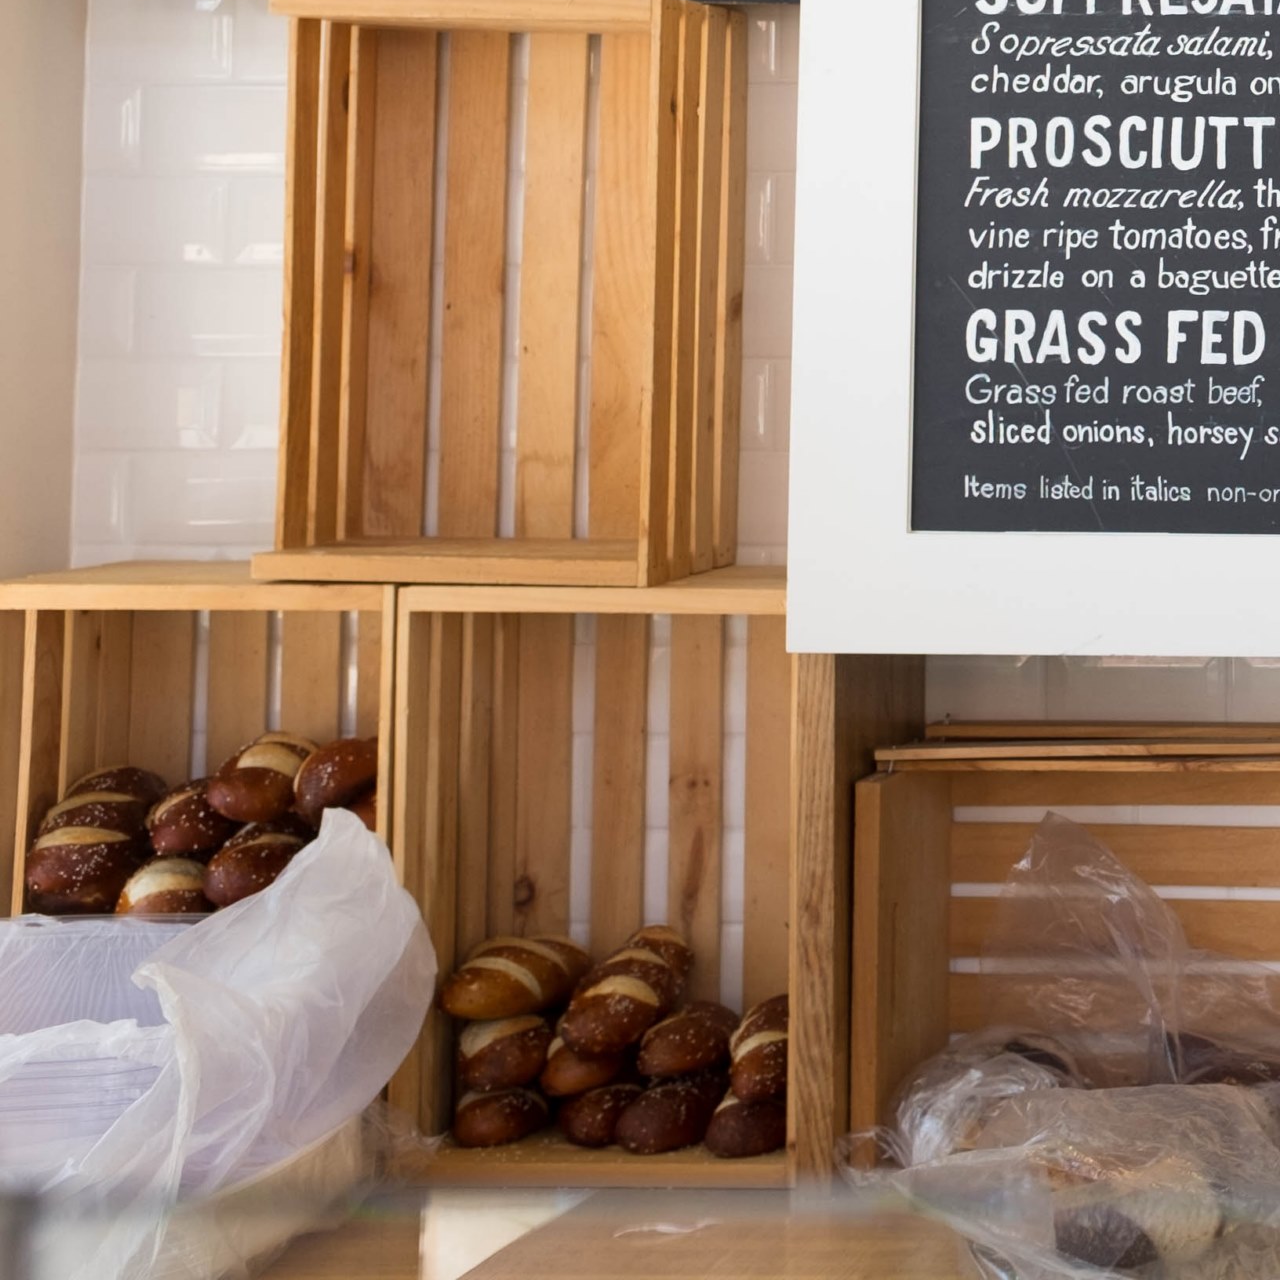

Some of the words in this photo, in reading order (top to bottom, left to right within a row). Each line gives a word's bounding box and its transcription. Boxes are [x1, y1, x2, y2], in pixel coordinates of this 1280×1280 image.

[966, 309, 1141, 365] GRASS
[1167, 310, 1265, 365] FED
[965, 475, 1026, 499] Items
[1041, 475, 1093, 499] listed
[1103, 480, 1119, 500] in
[1131, 475, 1190, 501] italics
